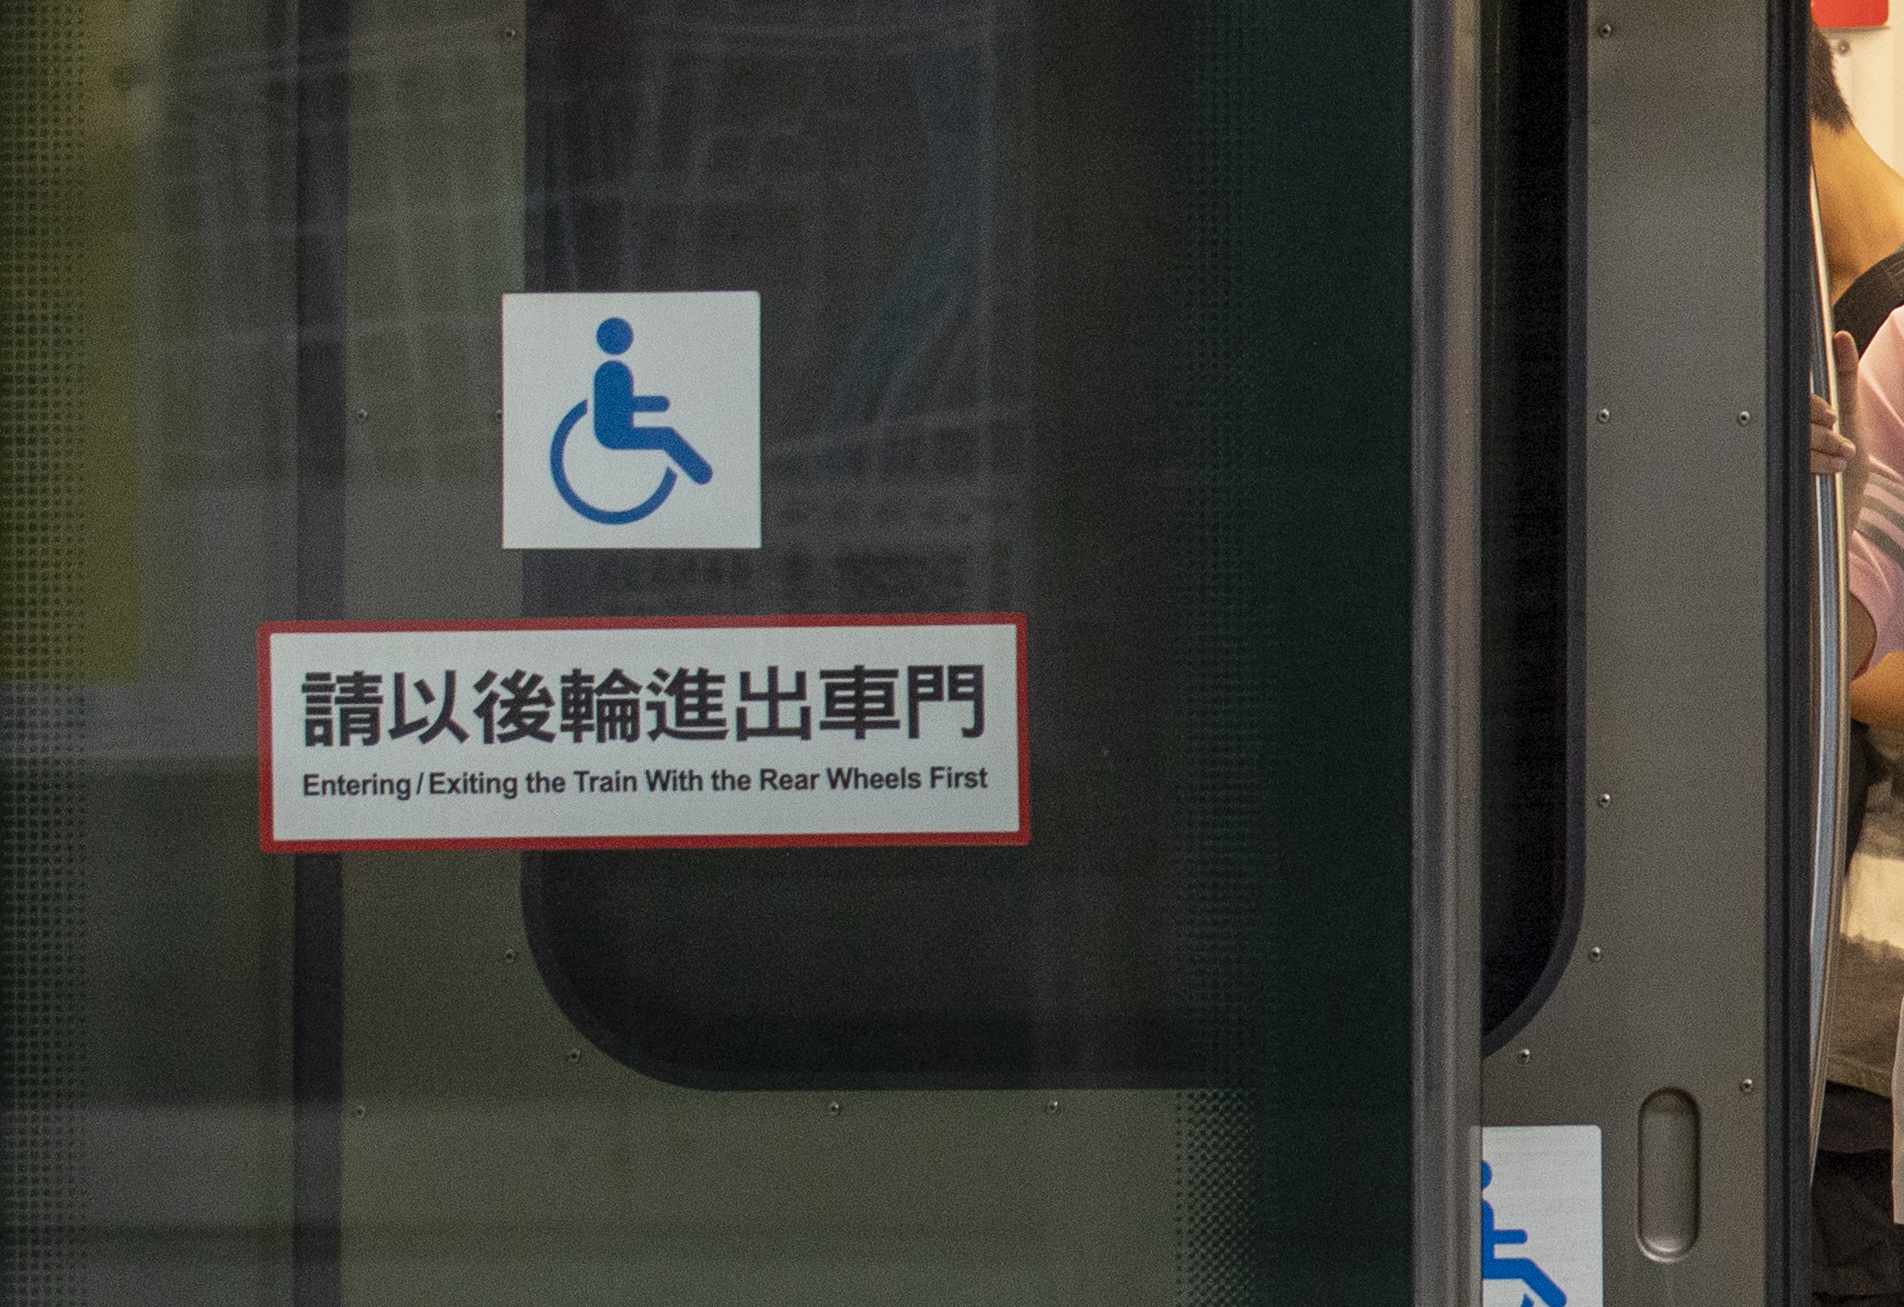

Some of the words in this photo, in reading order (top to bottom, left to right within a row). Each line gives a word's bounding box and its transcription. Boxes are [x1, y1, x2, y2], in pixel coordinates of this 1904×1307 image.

[302, 664, 986, 747] 請以後輪進出車門
[526, 771, 566, 794] the
[573, 770, 637, 793] Train
[645, 769, 704, 792] With
[711, 769, 751, 792] the
[759, 768, 820, 791] Rear
[827, 767, 922, 790] Wheels
[930, 766, 988, 789] First
